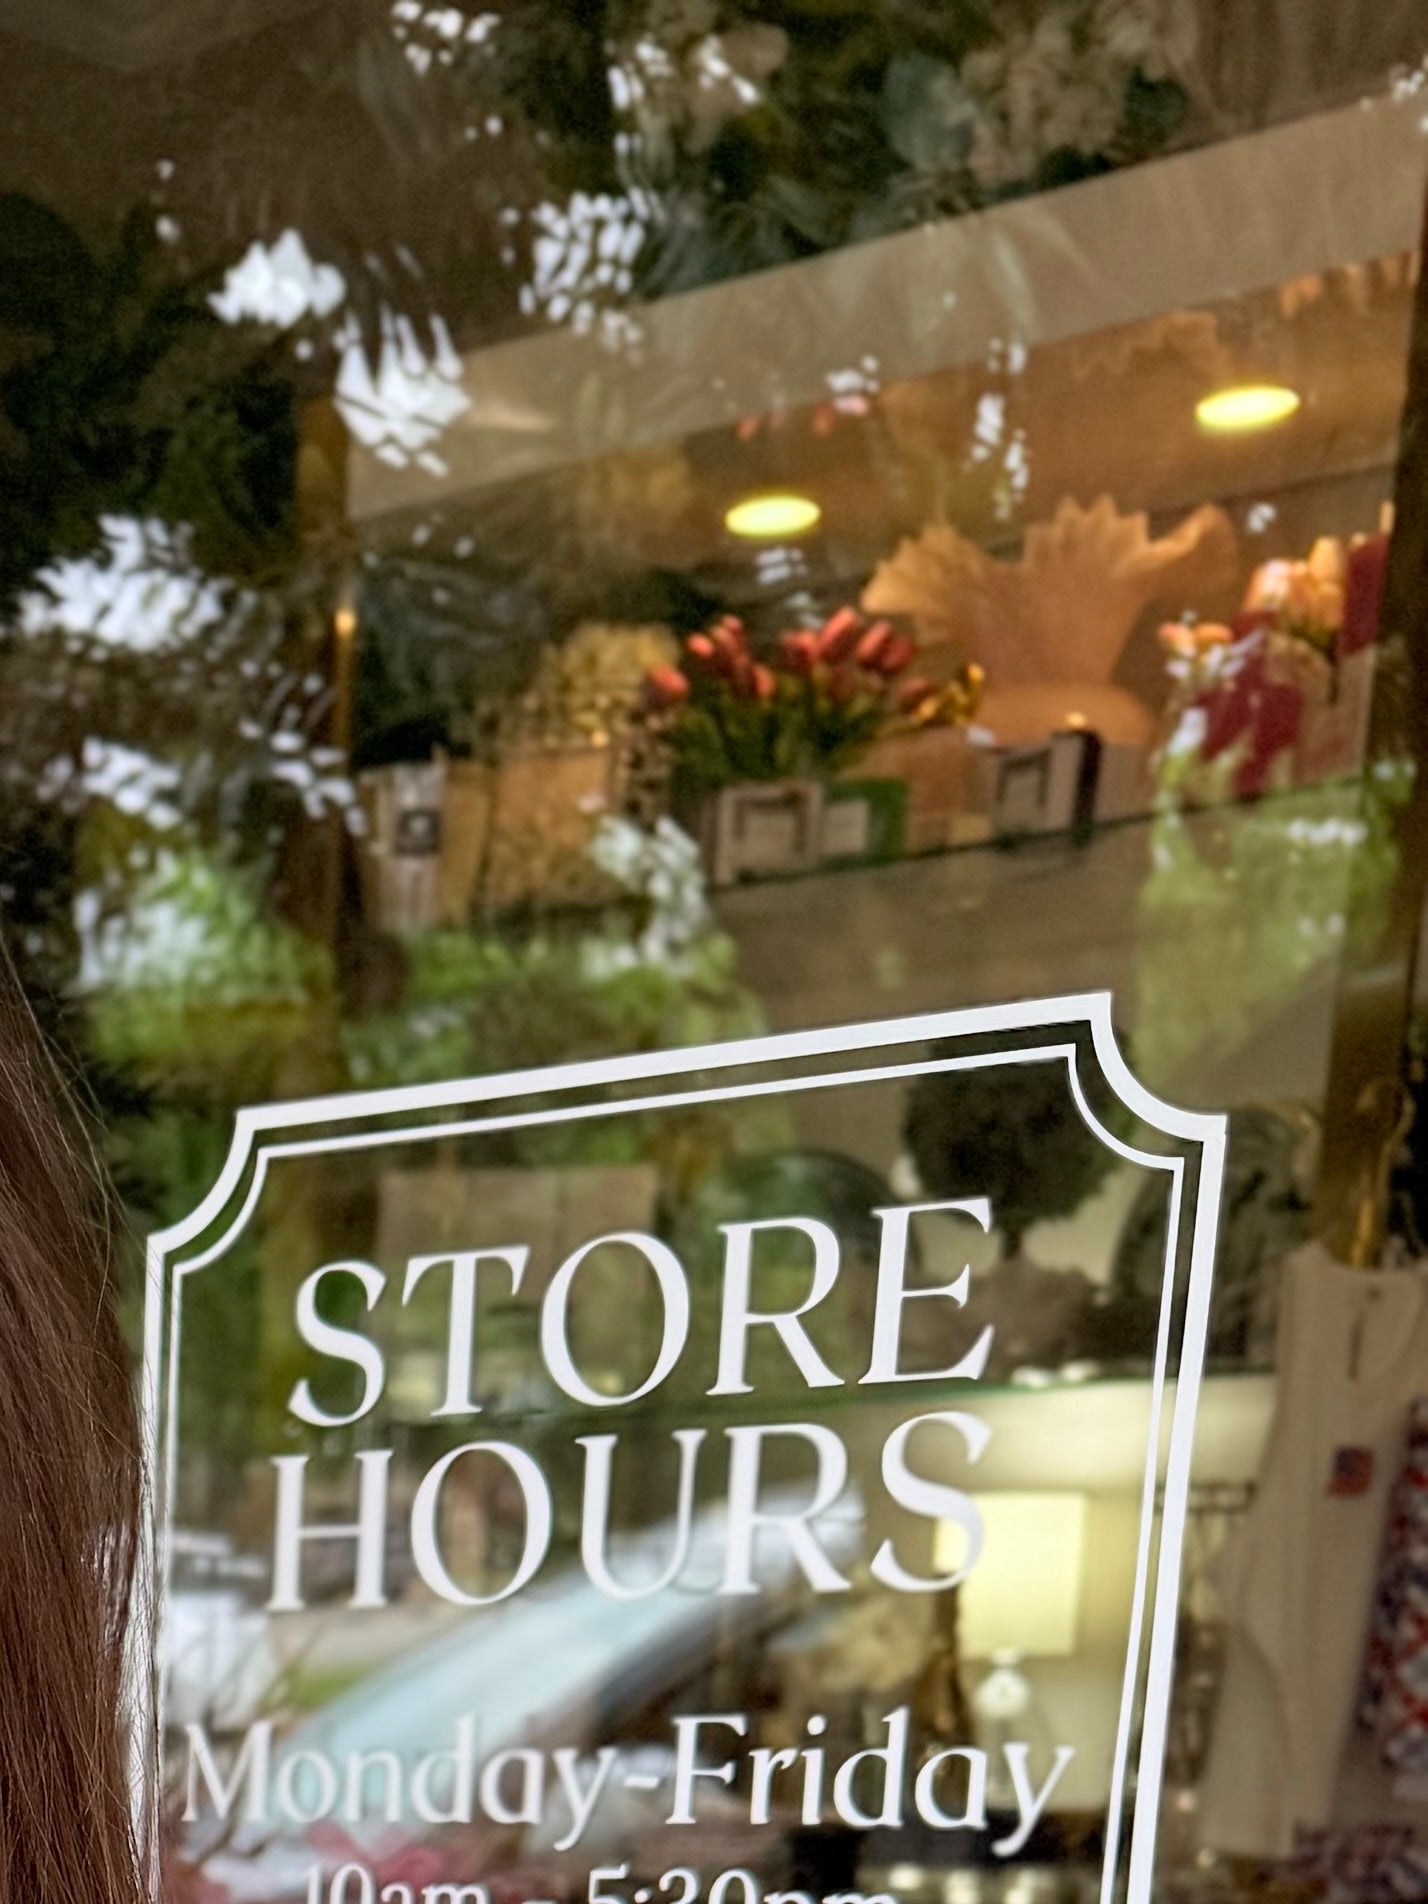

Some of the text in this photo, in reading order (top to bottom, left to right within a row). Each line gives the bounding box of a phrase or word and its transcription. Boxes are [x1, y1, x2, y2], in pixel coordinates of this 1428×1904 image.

[290, 1196, 996, 1428] STORE
[270, 1410, 991, 1611] HOURS
[182, 1706, 1075, 1857] Monday-Friday
